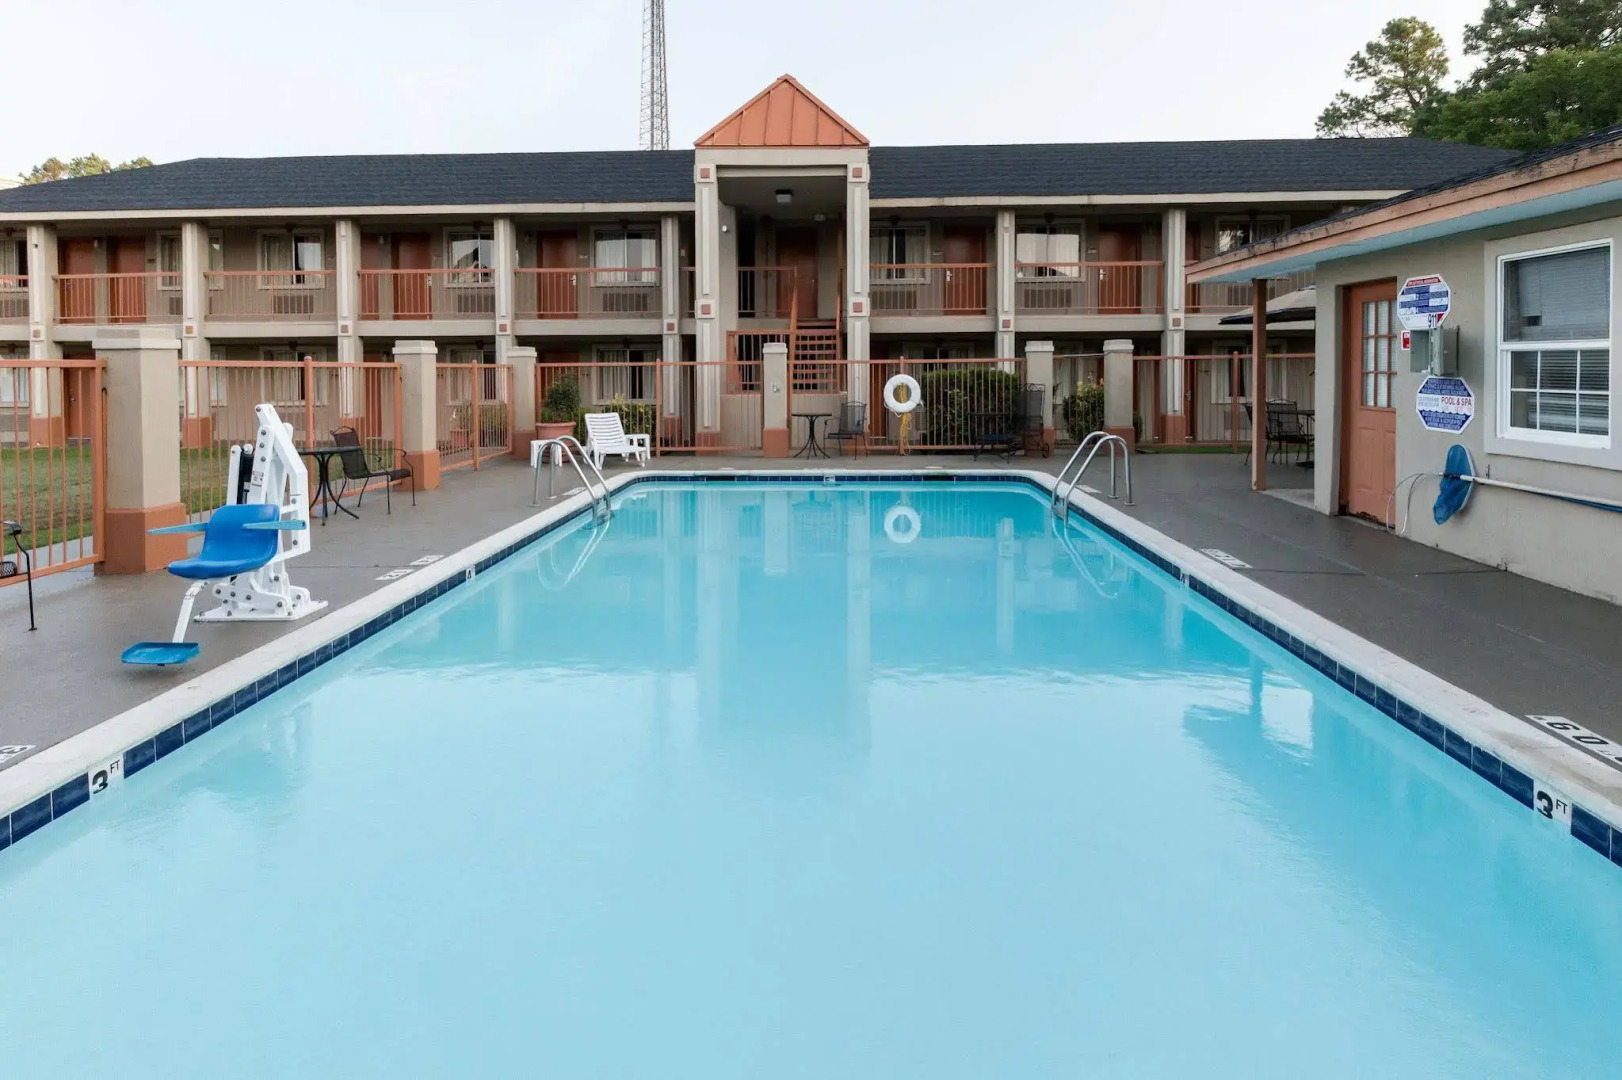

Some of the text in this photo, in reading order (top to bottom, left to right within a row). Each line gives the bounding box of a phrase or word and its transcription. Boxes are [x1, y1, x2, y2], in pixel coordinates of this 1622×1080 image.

[1428, 313, 1437, 328] 911
[1441, 396, 1456, 406] POOL
[1461, 397, 1472, 407] SPA
[92, 759, 120, 794] 3 FT
[1536, 790, 1568, 819] 3 FT
